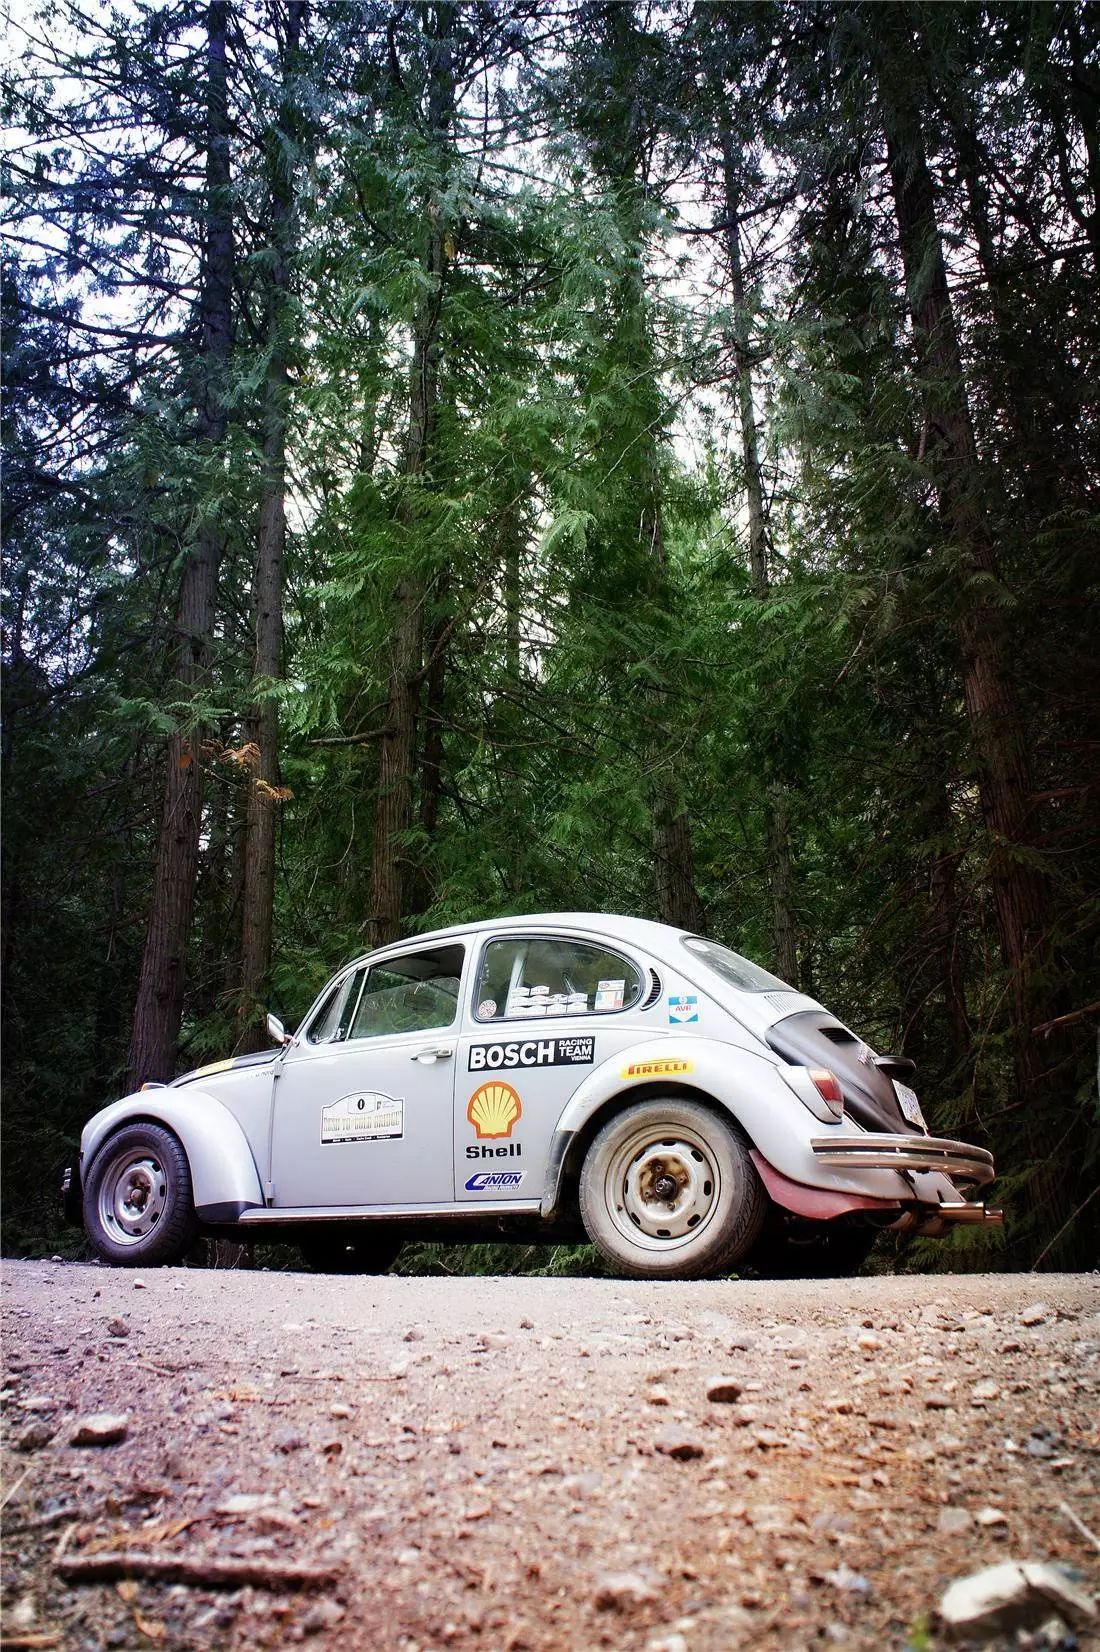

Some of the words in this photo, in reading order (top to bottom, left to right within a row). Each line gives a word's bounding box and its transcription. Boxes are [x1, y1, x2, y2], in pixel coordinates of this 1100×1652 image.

[559, 1038, 592, 1047] RACING
[559, 1045, 592, 1056] TEAM
[470, 1040, 555, 1069] BOSCH
[628, 1058, 687, 1075] PIRELLI
[466, 1143, 521, 1159] Shell
[464, 1172, 522, 1190] CANTON
